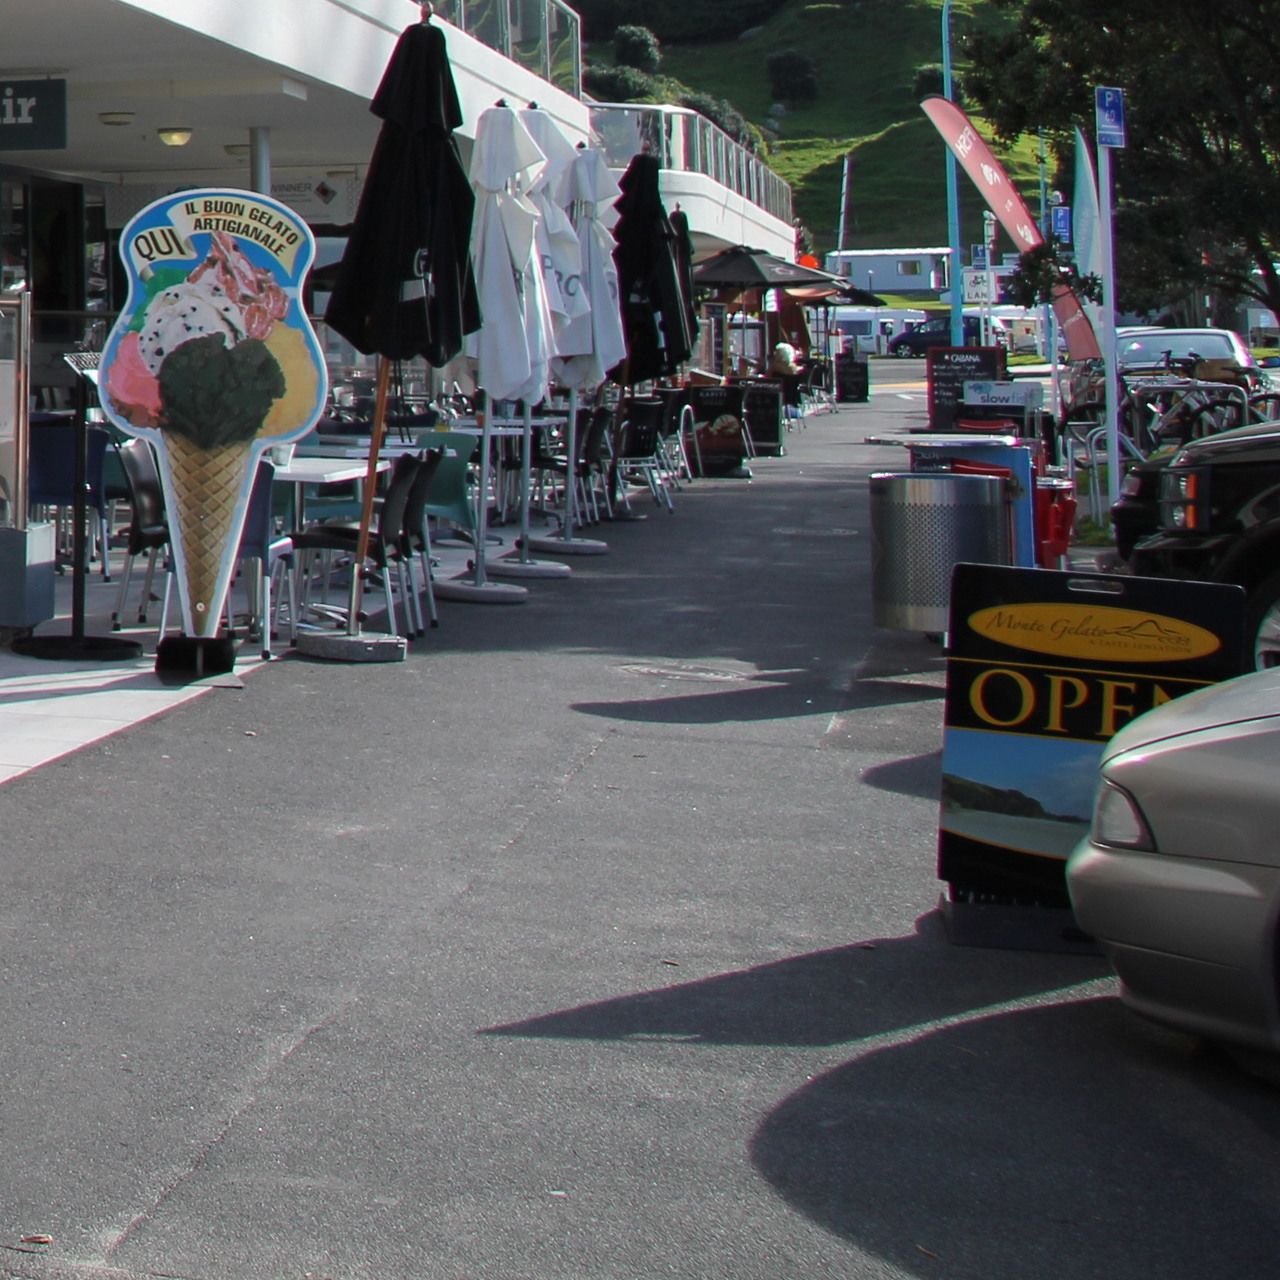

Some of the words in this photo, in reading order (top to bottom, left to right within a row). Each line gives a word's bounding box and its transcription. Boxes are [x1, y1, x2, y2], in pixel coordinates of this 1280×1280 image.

[1104, 91, 1113, 108] P
[185, 202, 199, 216] IL
[203, 200, 245, 216] BUON
[249, 206, 299, 246] GELATO
[193, 217, 287, 257] ARTIGIANALE
[134, 228, 186, 261] QUI
[986, 611, 1046, 634] Monte
[1050, 615, 1106, 641] Gelato
[969, 668, 1175, 737] OPE
